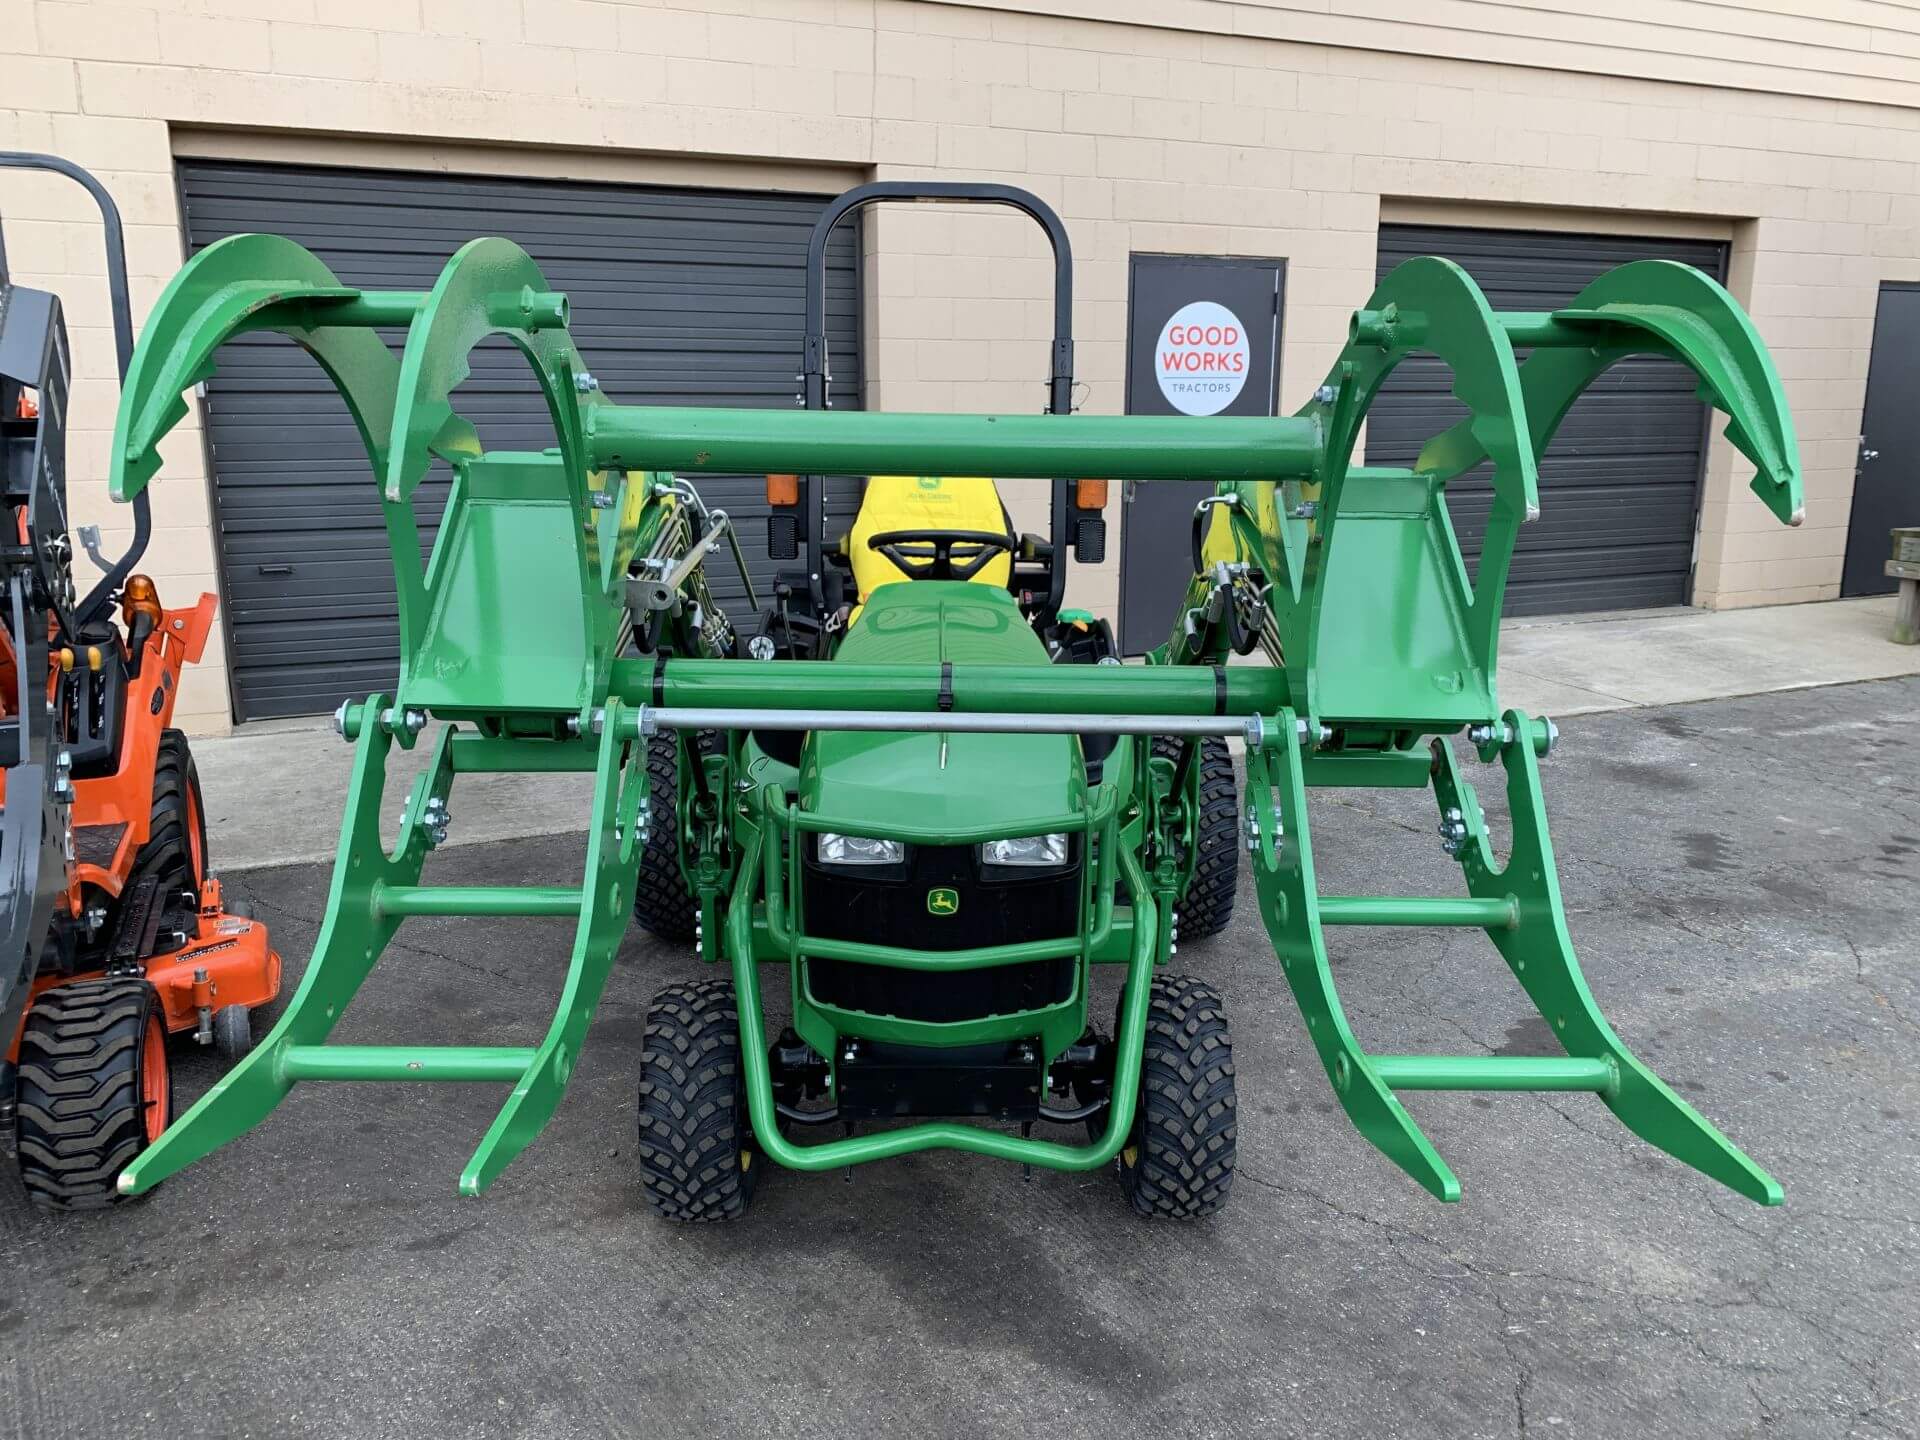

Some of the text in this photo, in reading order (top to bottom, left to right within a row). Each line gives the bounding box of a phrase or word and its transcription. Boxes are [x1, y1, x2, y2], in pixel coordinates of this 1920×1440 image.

[1169, 325, 1238, 346] GOOD
[1162, 351, 1244, 372] WORKS
[1172, 383, 1231, 393] TRACTORS
